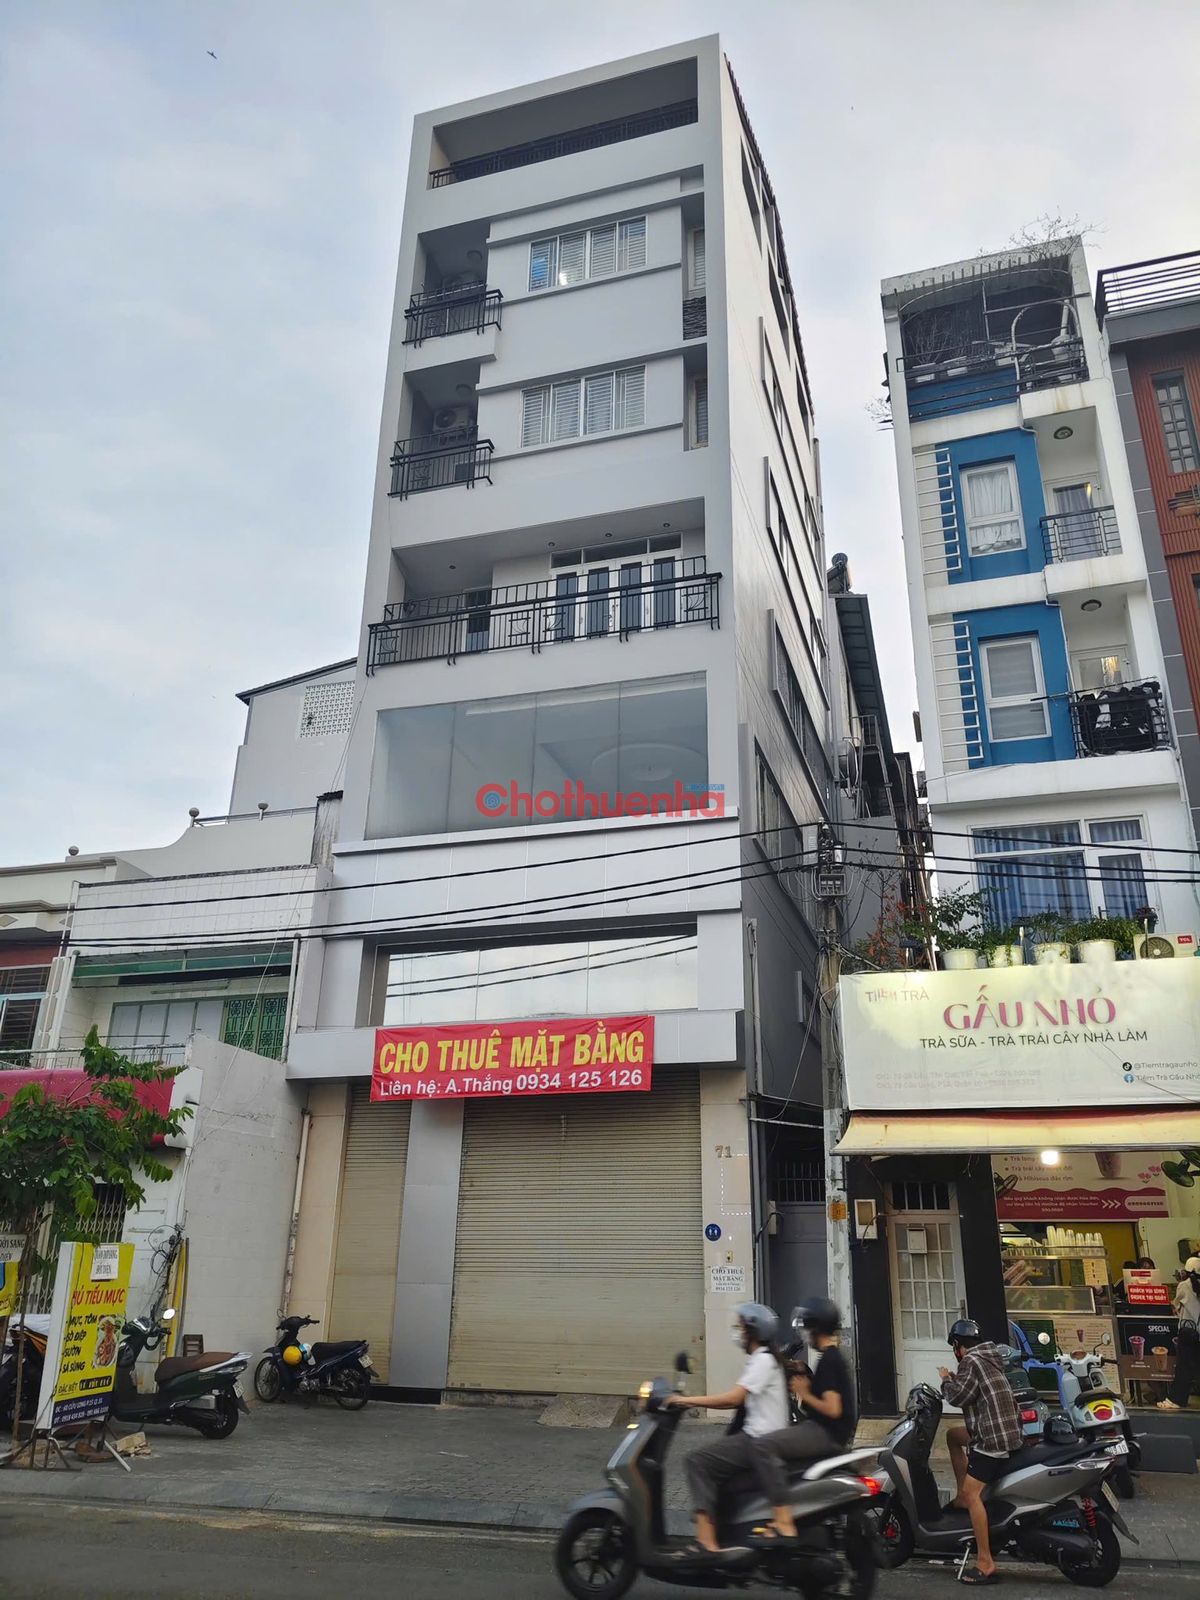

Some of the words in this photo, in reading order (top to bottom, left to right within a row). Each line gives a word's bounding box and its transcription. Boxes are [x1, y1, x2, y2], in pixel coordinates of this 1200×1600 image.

[901, 986, 929, 1001] TRÀ
[943, 985, 1024, 1030] GẤU
[1034, 986, 1117, 1026] NHỎ
[379, 1041, 429, 1074] CHO
[437, 1029, 502, 1072] THUÊ
[510, 1028, 566, 1073] MẶT
[573, 1020, 645, 1065] BẰNG
[920, 1035, 948, 1049] TRÀ
[950, 1033, 977, 1048] SỮA
[989, 1031, 1016, 1047] TRÀ
[1018, 1030, 1050, 1046] TRÁI
[1052, 1030, 1079, 1045] CÂY
[1084, 1028, 1115, 1043] NHÀ
[1118, 1027, 1148, 1042] LÀM
[379, 1080, 412, 1096] Liên
[416, 1078, 441, 1098] hệ:
[444, 1074, 513, 1095] A.Thắng
[515, 1072, 562, 1091] 0934
[568, 1071, 602, 1088] 125
[608, 1069, 643, 1086] 126
[714, 1144, 732, 1159] 71
[1148, 1324, 1171, 1333] SPECIAL
